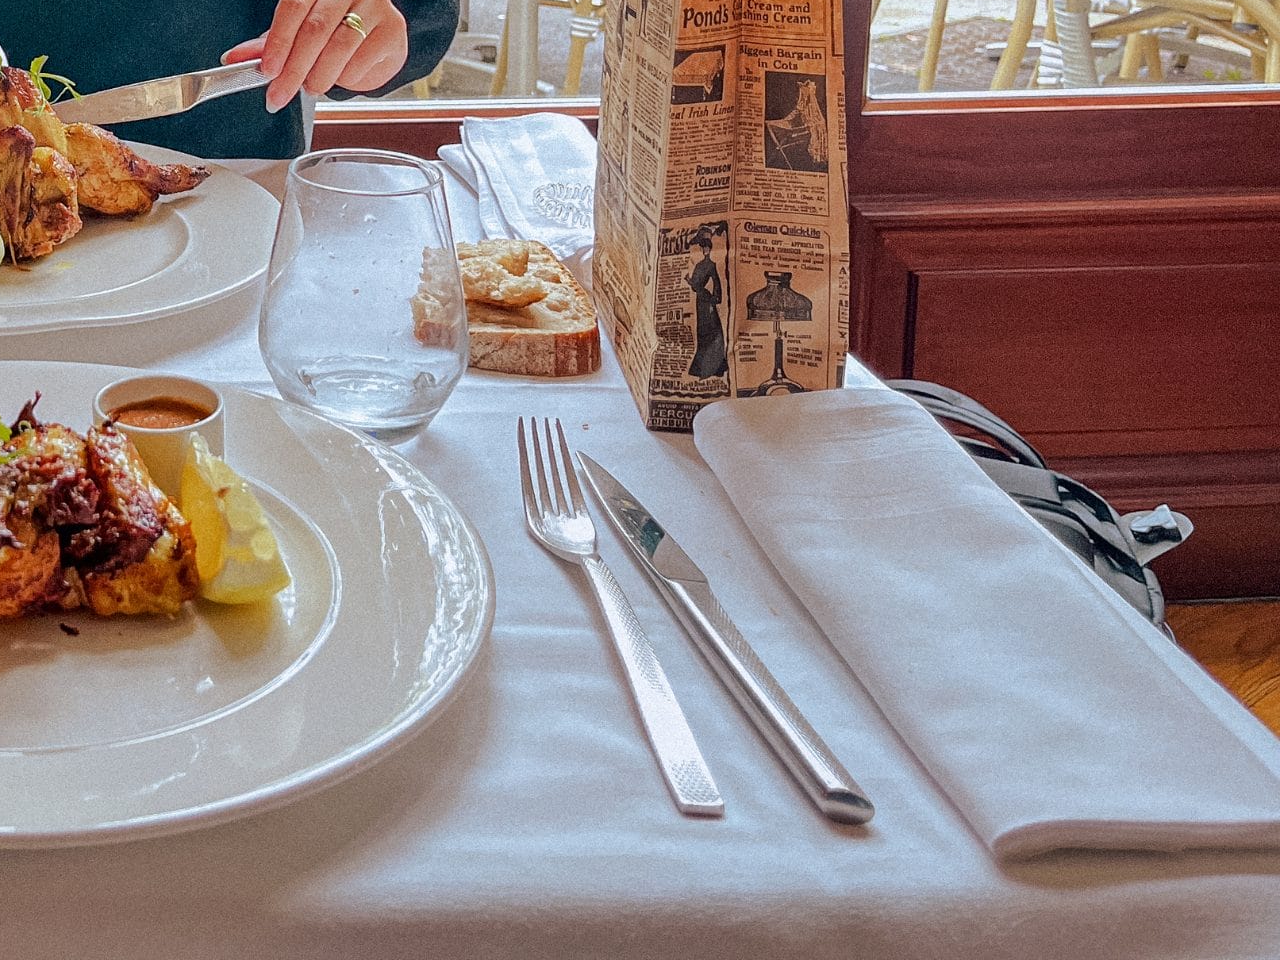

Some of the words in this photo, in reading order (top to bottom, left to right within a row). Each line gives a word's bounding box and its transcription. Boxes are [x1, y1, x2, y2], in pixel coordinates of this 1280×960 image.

[789, 2, 811, 13] and
[683, 4, 729, 28] Pond's
[773, 12, 811, 25] Cream
[740, 45, 773, 58] Biggest
[777, 49, 822, 61] Bargain
[757, 60, 768, 69] in
[773, 60, 798, 70] Cots
[669, 107, 686, 119] eal
[688, 105, 709, 119] Irish
[695, 163, 732, 177] ROBINSON
[698, 176, 731, 188] CLEAVER
[744, 221, 778, 234] Coleman
[660, 228, 694, 255] Thrift
[652, 408, 693, 420] FERGU
